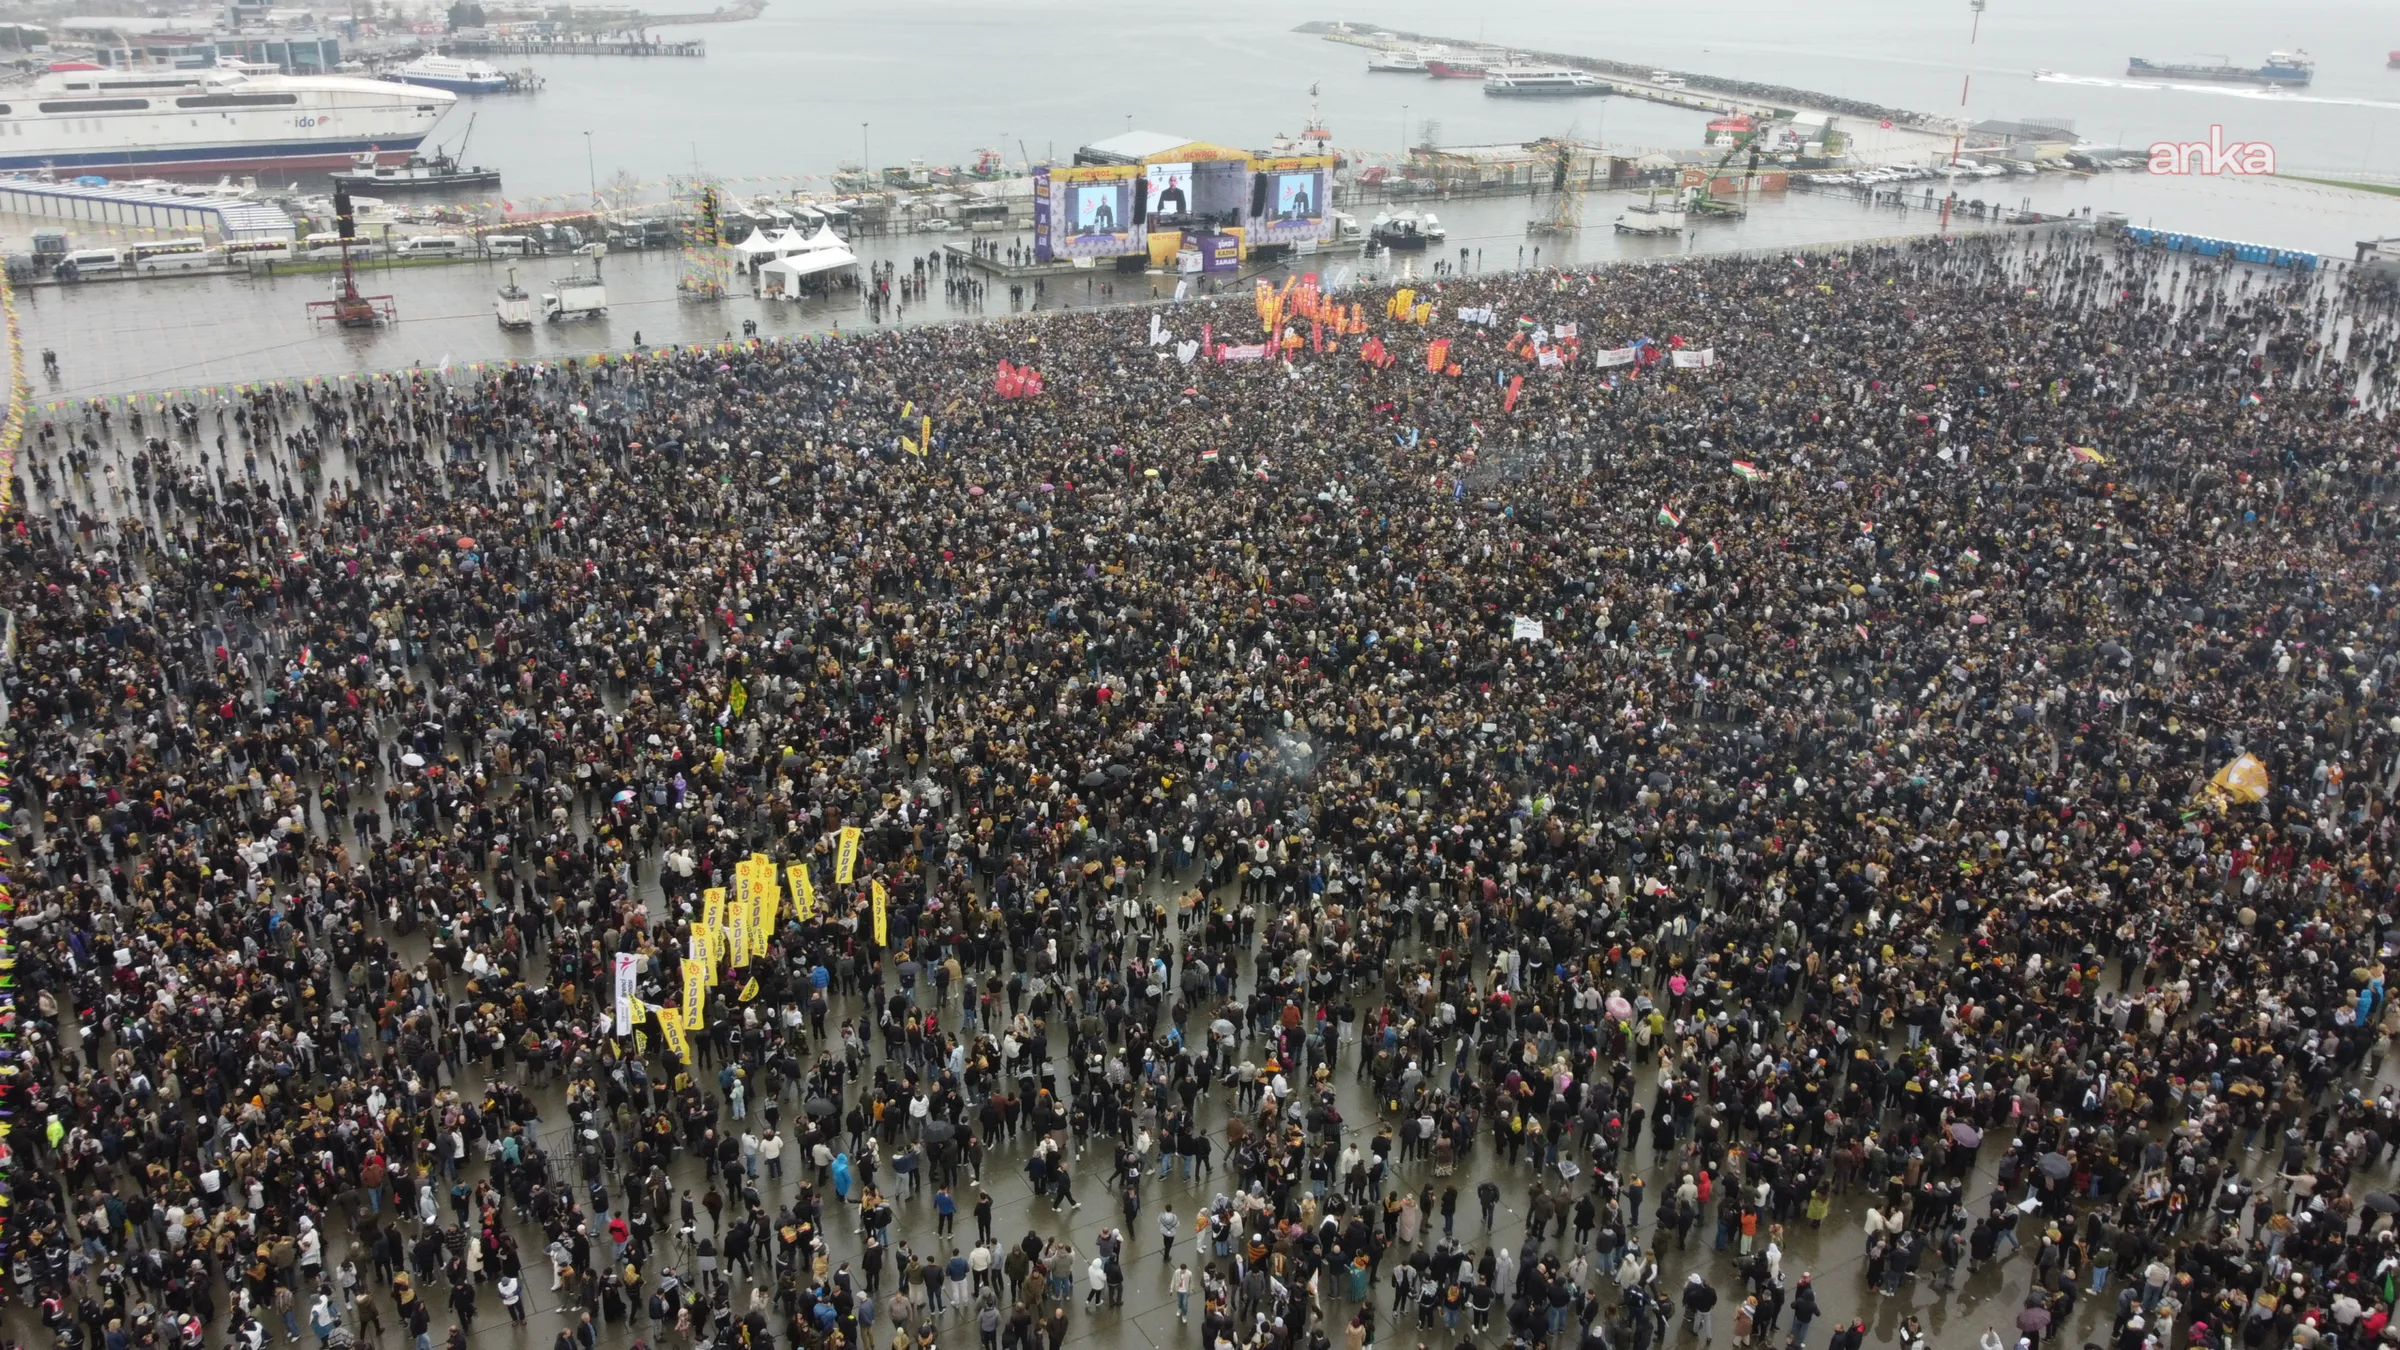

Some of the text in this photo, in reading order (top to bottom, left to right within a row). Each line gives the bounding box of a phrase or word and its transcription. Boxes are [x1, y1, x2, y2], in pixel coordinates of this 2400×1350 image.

[295, 117, 315, 127] ido
[1183, 150, 1217, 159] NEWROZ
[839, 840, 852, 882] SODAP
[734, 918, 742, 965] SODAP
[688, 978, 698, 1027] SODAP
